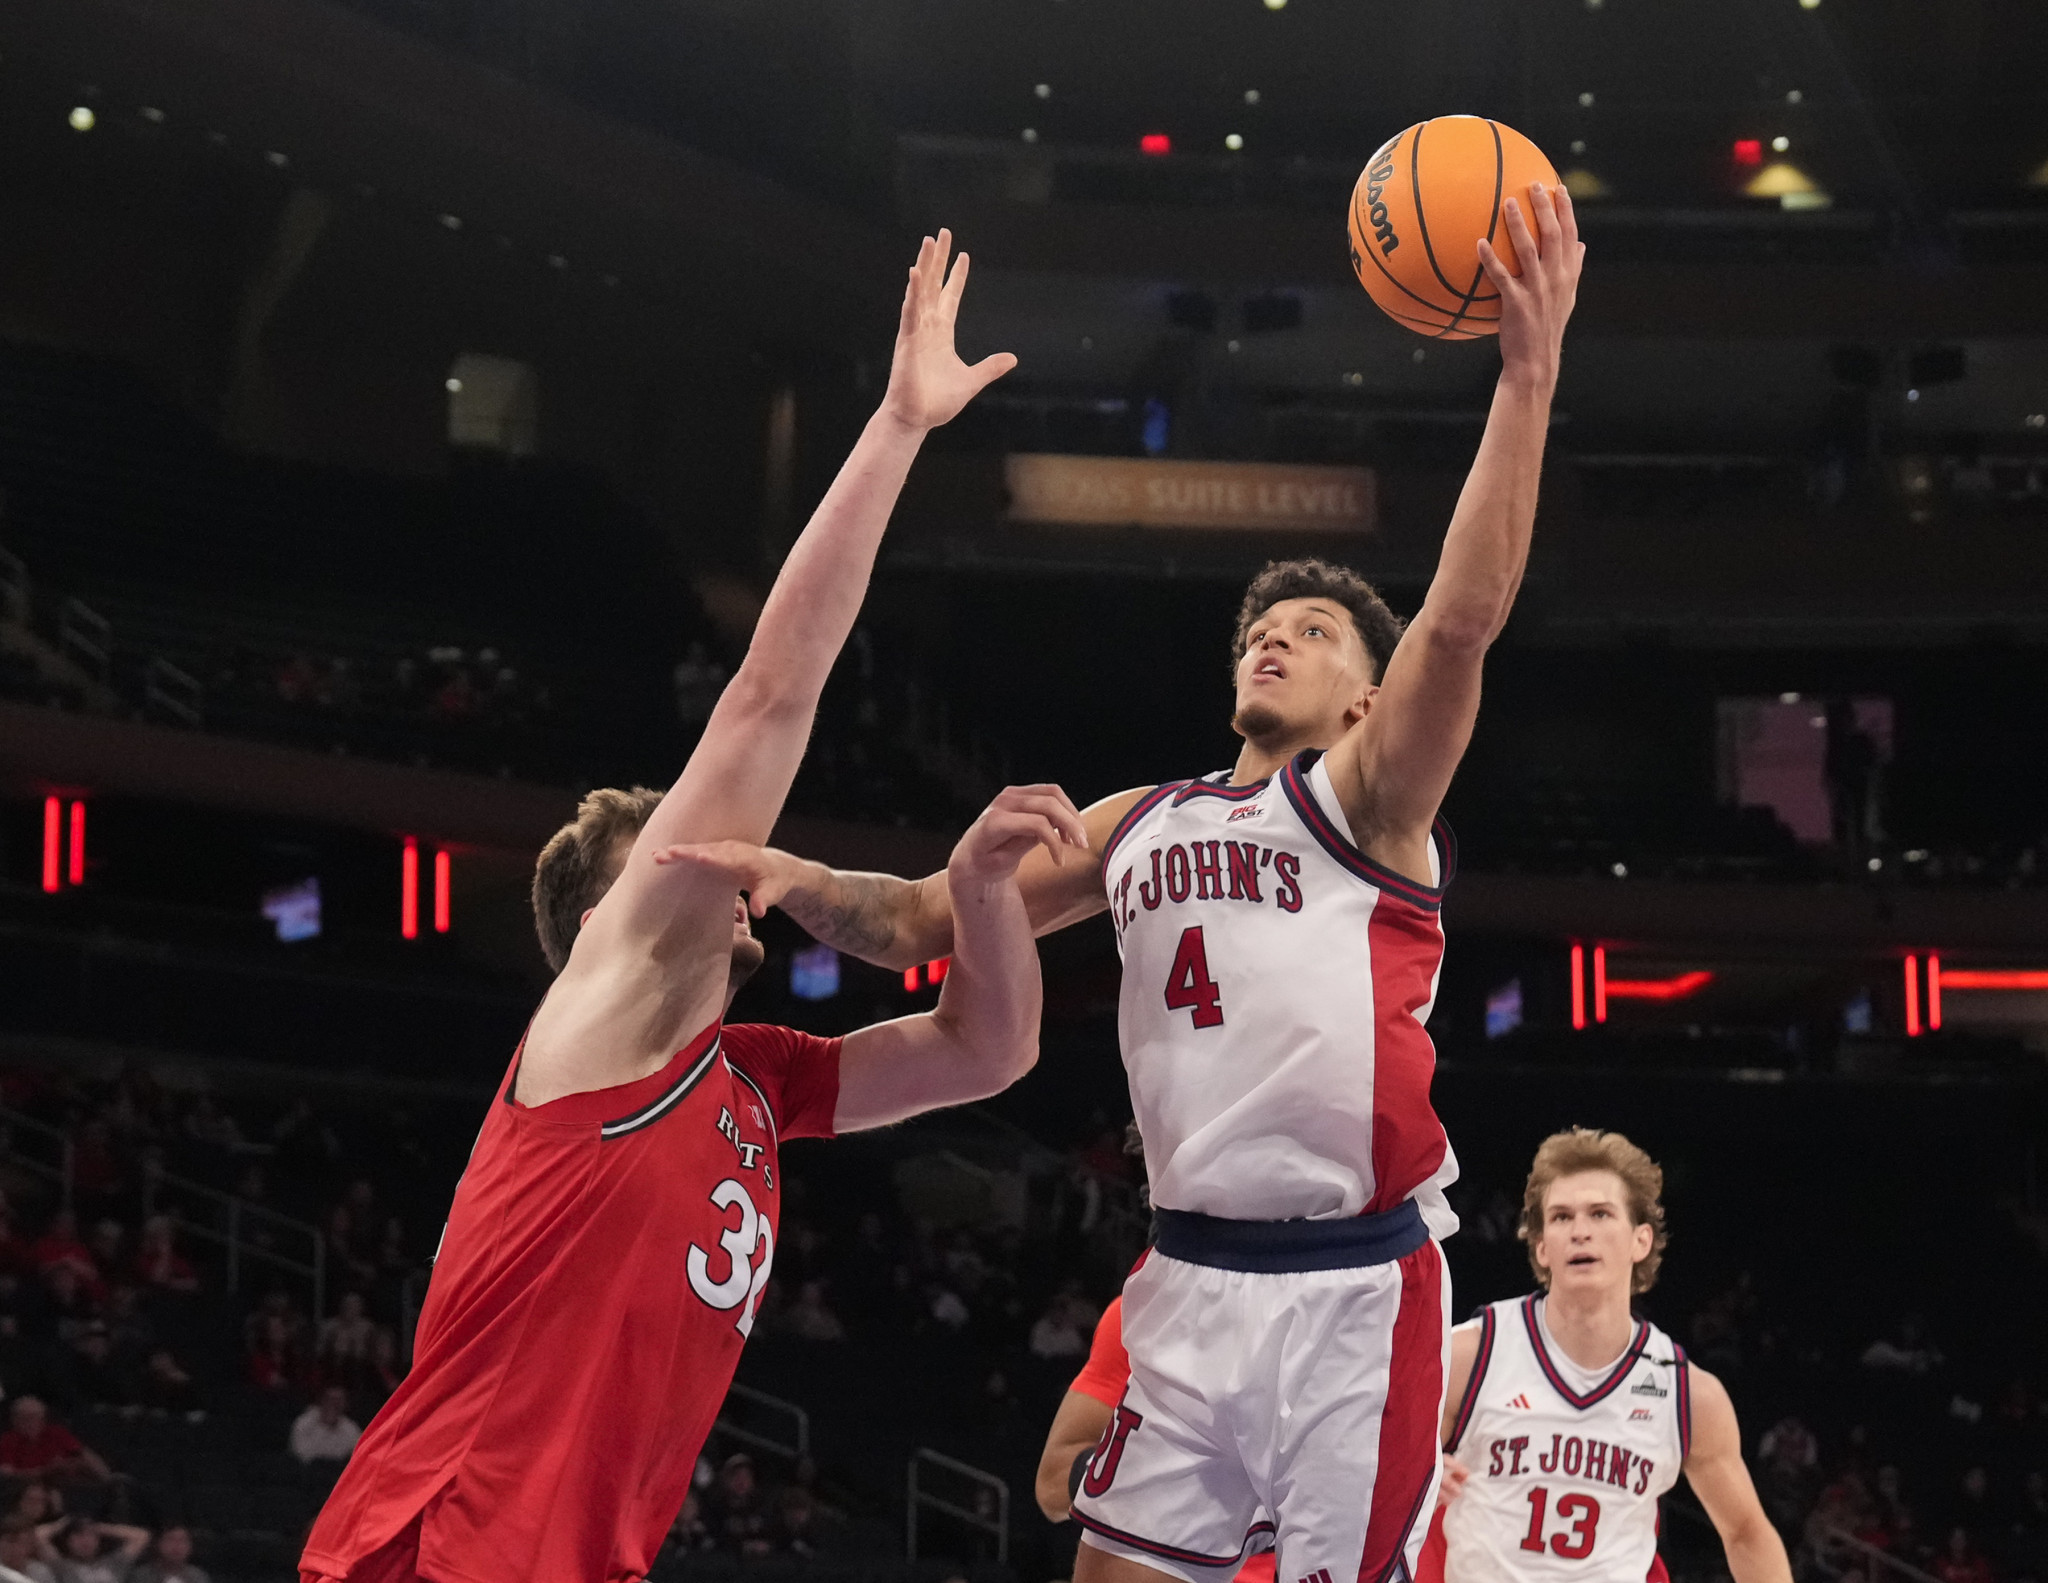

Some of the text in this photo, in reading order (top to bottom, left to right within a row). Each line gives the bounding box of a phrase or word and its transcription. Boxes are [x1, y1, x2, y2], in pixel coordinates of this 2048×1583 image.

[1146, 478, 1247, 512] SUITE
[1257, 481, 1359, 517] LEVEL
[1226, 808, 1265, 822] EAST
[1231, 804, 1258, 816] BIG
[1138, 839, 1304, 914] JOHN'S
[1164, 924, 1225, 1031] 4
[685, 1177, 775, 1342] 32
[1488, 1433, 1655, 1496] ST. JOHN'S
[1519, 1485, 1601, 1560] 13
